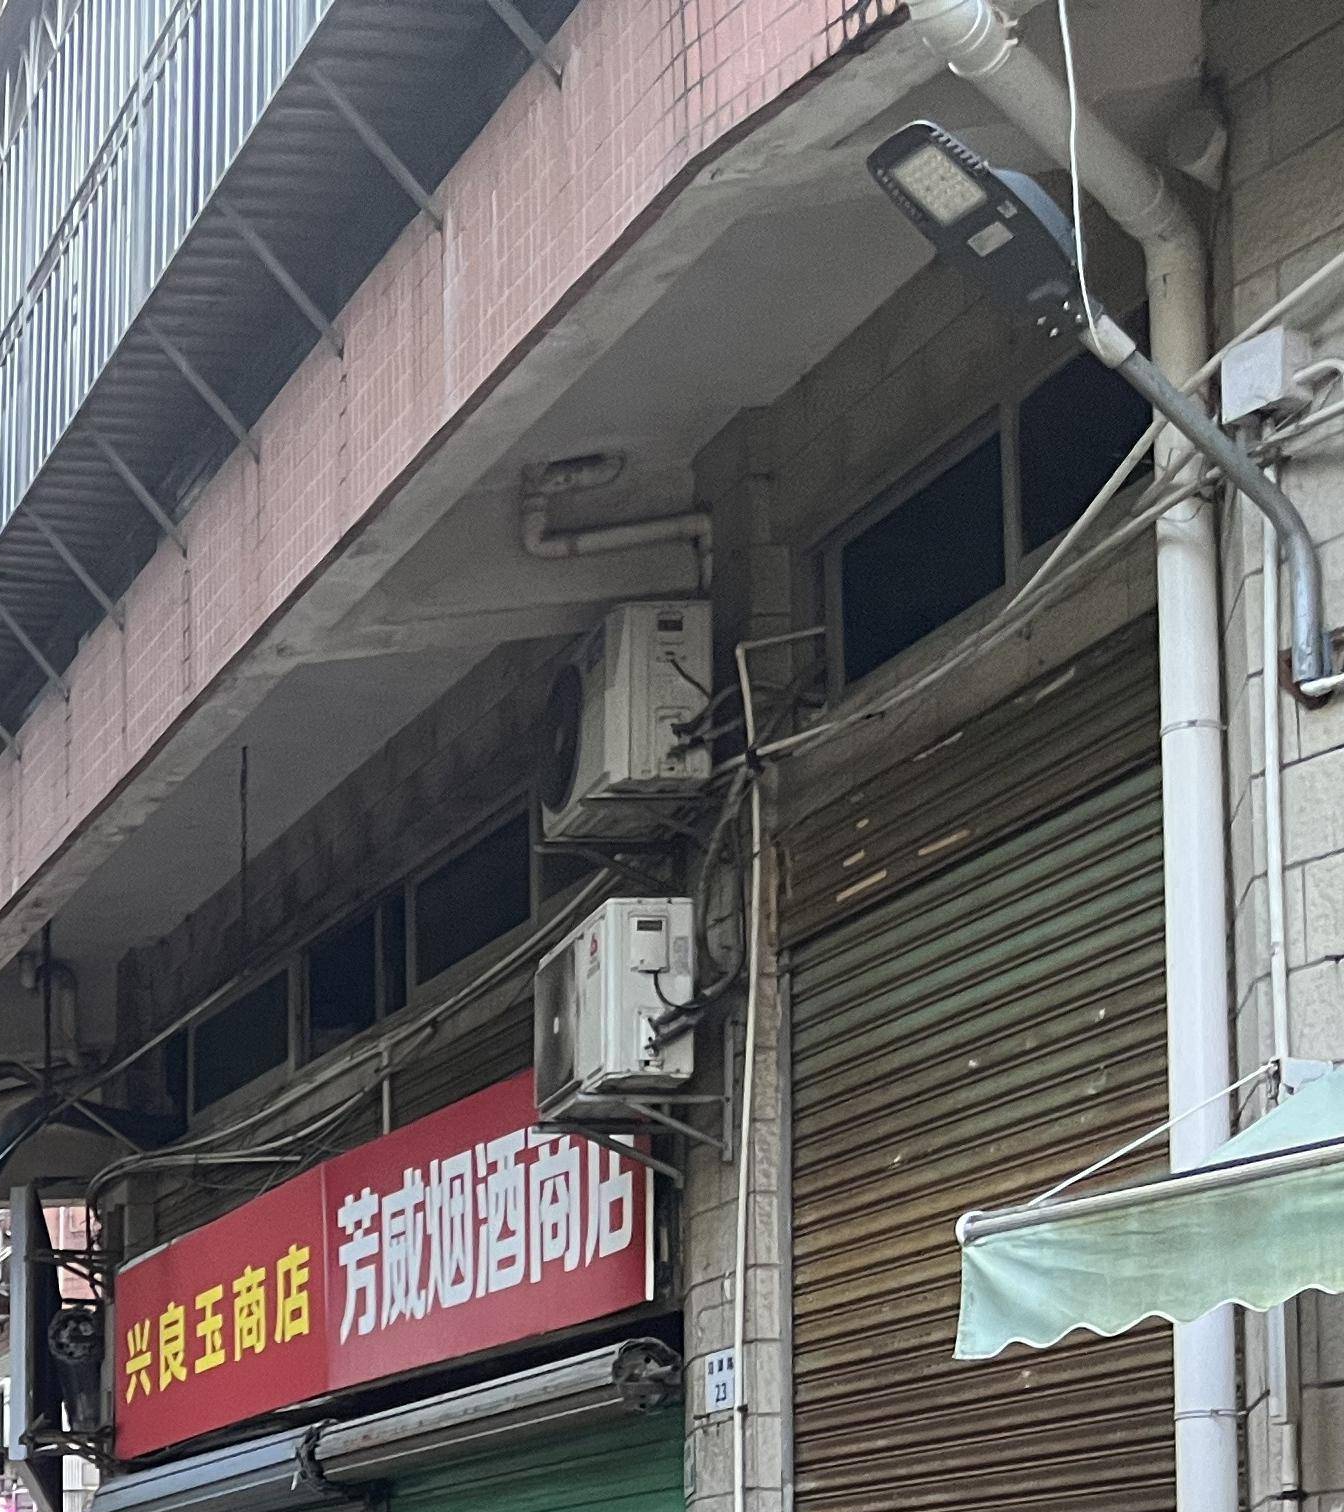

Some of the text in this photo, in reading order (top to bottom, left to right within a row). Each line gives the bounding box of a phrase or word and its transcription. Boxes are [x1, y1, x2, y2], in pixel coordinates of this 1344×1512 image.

[126, 1243, 310, 1404] 兴良玉商店
[715, 1382, 727, 1403] 23
